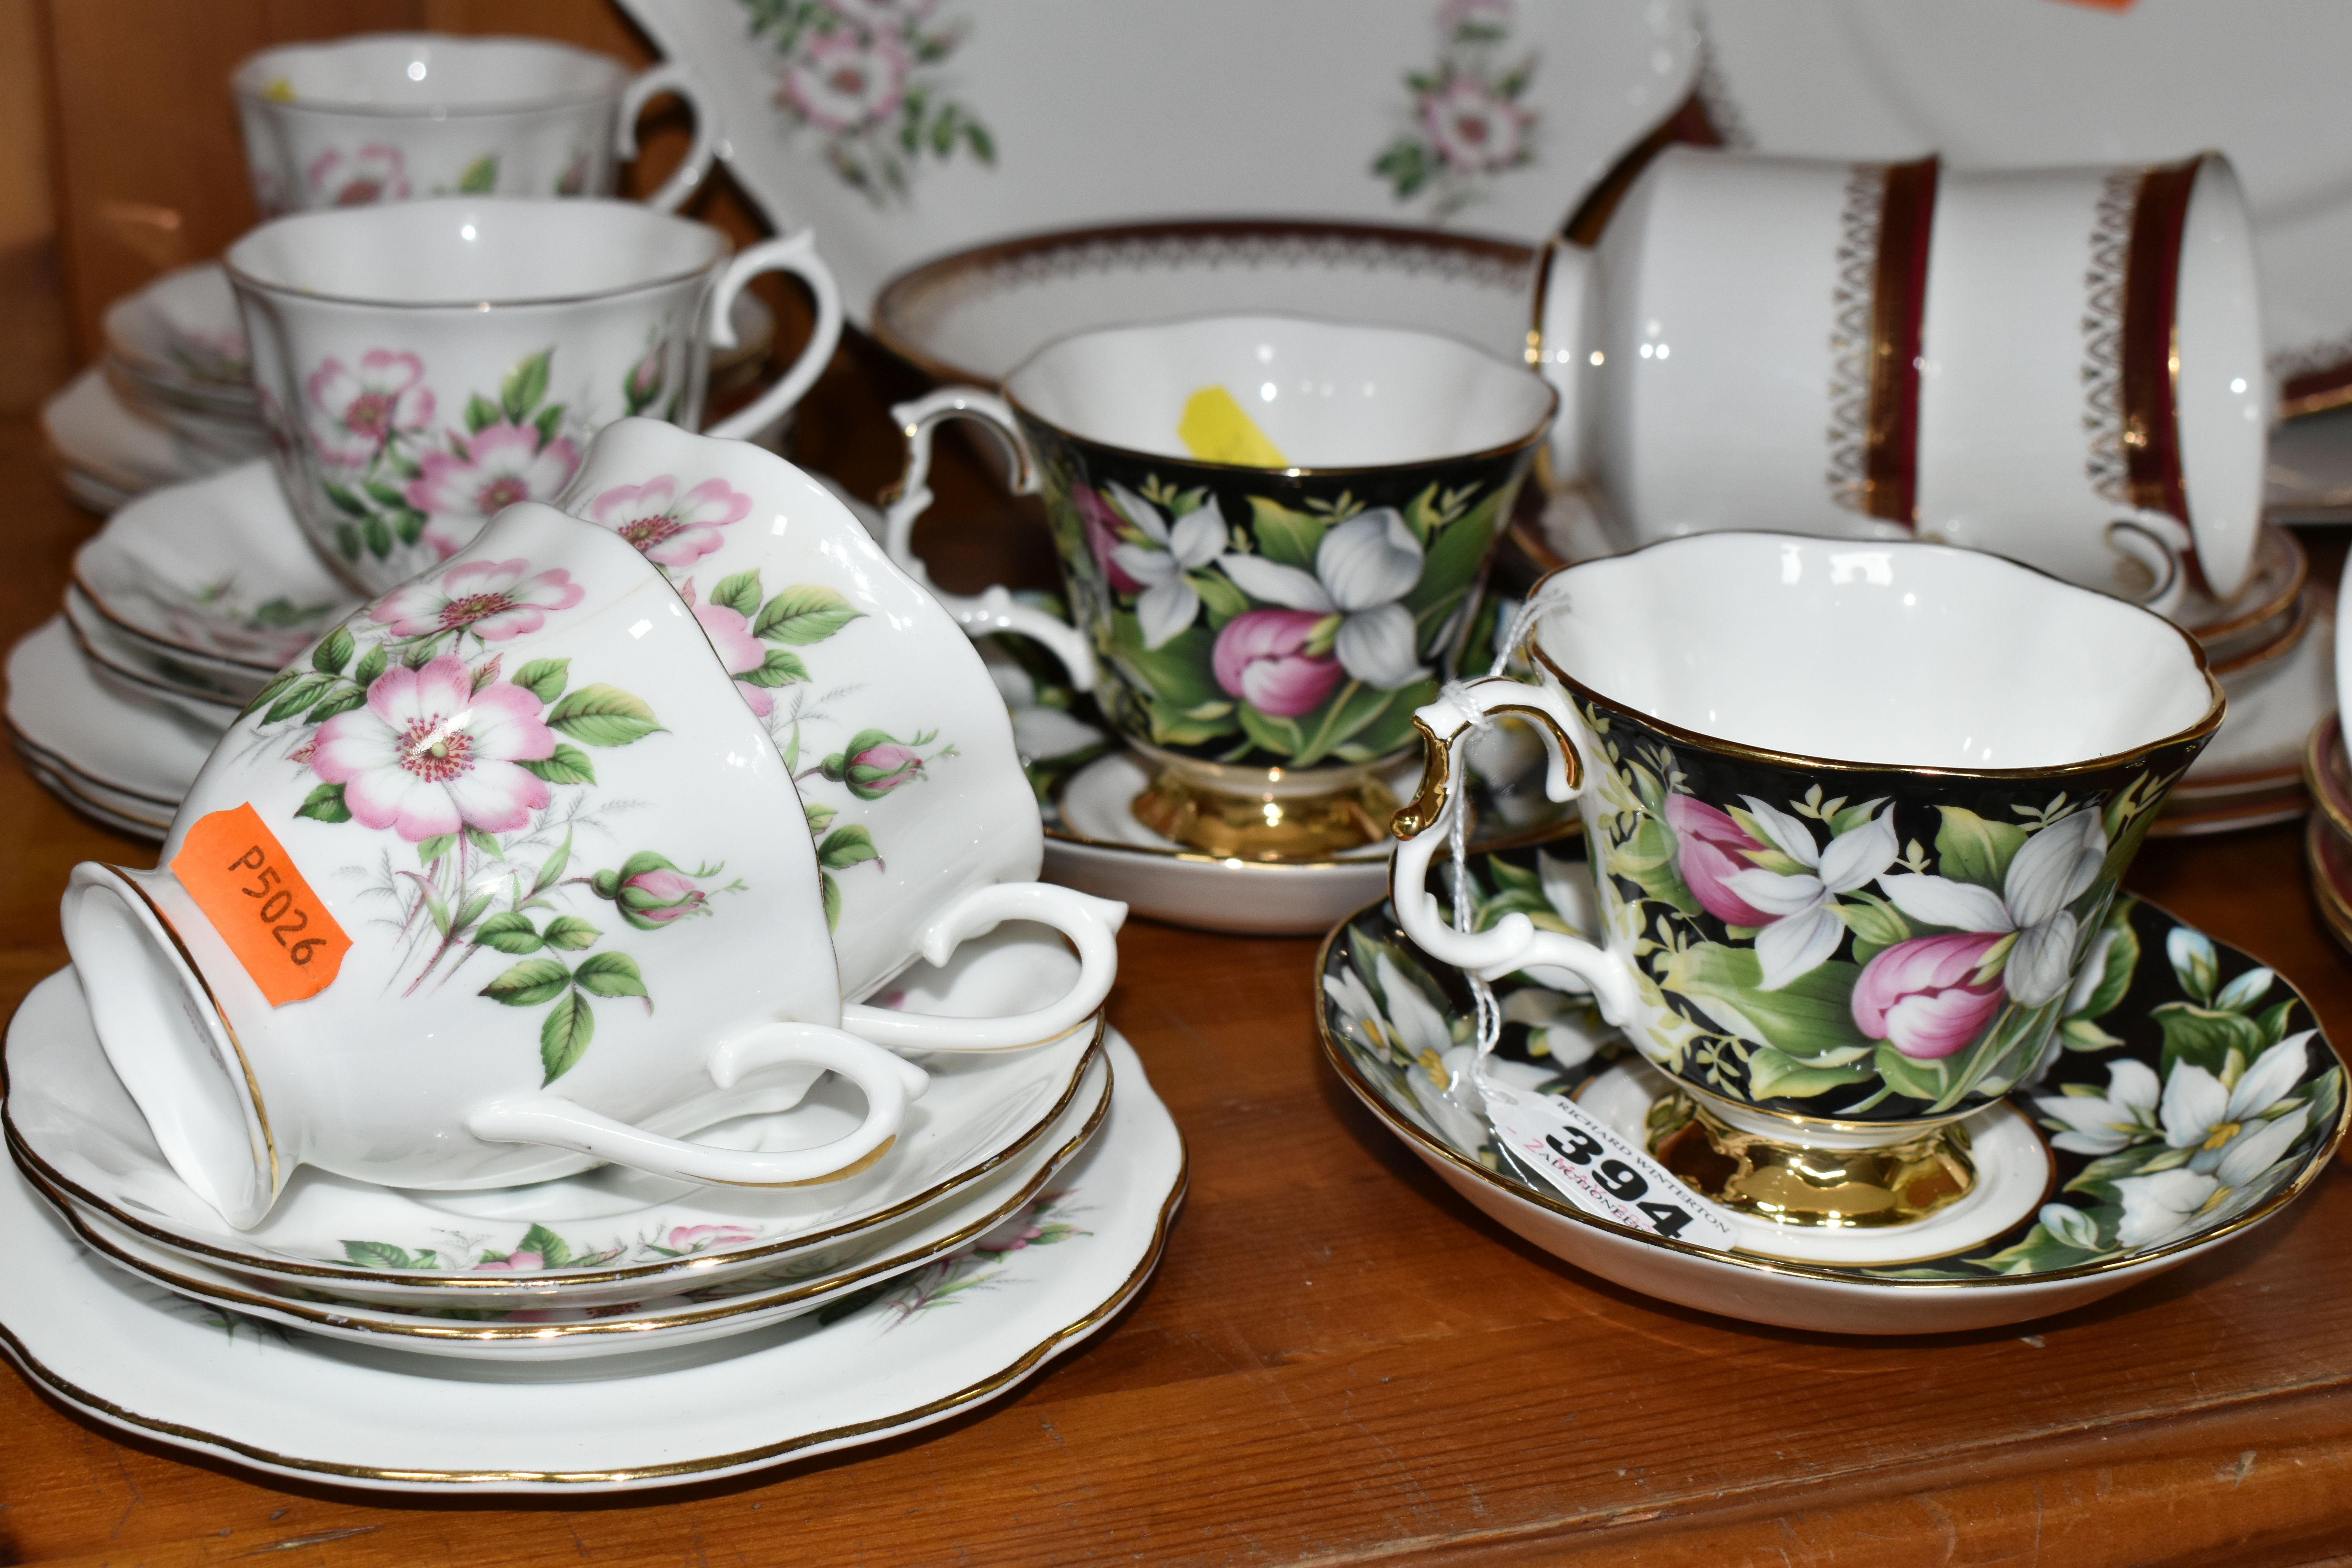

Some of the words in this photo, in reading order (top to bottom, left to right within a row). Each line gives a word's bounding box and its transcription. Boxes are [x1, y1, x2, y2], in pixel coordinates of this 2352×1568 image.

[228, 845, 327, 965] P5026
[1545, 1125, 1694, 1239] 394
[1557, 1102, 1632, 1155] RICHARD
[1637, 1156, 1730, 1233] WINTERTON
[1610, 1204, 1661, 1234] 202
